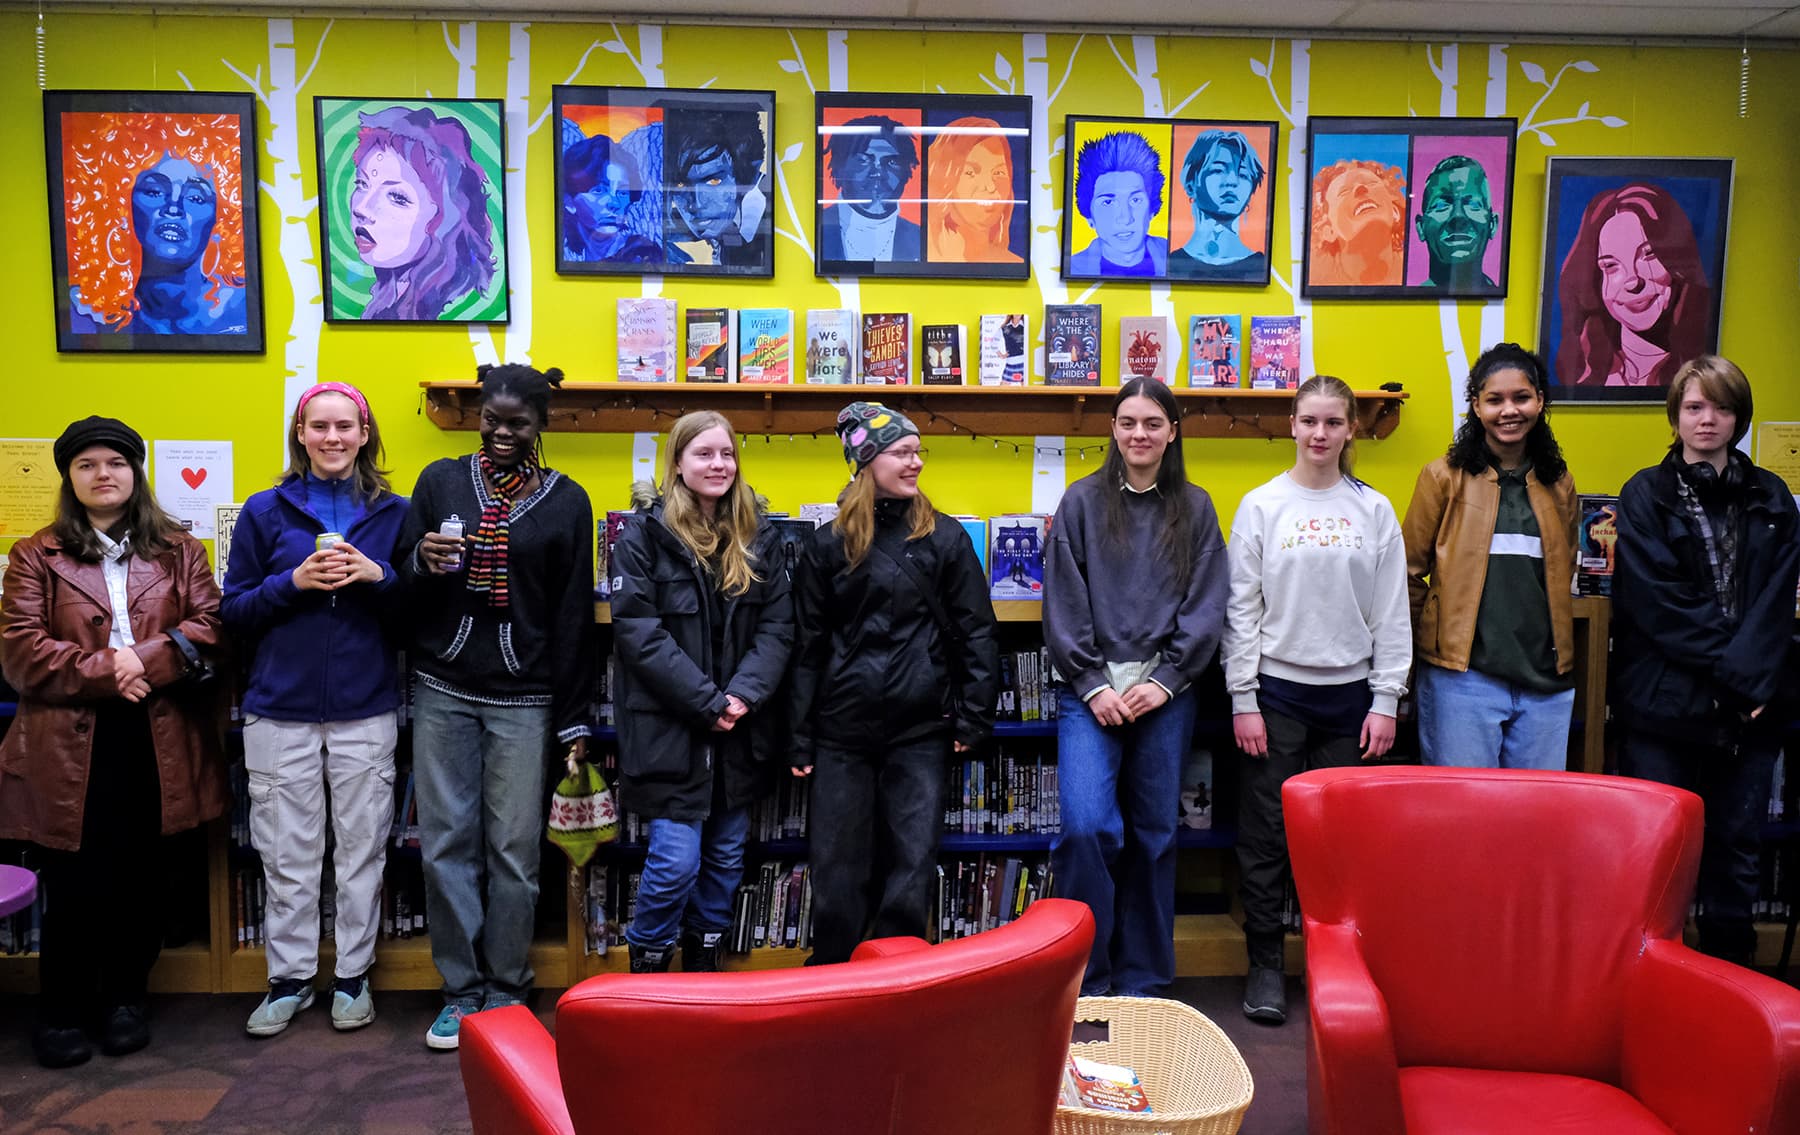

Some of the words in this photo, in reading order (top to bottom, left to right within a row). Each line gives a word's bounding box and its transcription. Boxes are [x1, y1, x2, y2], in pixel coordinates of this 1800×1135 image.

[751, 319, 778, 329] WHEN
[1059, 317, 1089, 326] WHERE
[819, 331, 838, 341] we
[928, 329, 952, 340] tithe
[1066, 326, 1082, 335] THE
[1203, 322, 1229, 341] MY
[749, 337, 779, 347] WORLD
[754, 347, 776, 359] TIPS
[812, 346, 847, 357] were
[870, 341, 901, 363] GAMBIT
[1192, 343, 1240, 360] SALTY
[751, 360, 777, 370] OVER
[813, 360, 843, 376] liars
[1058, 360, 1090, 369] LIBRARY
[1062, 370, 1085, 378] HIDES
[1192, 364, 1239, 382] MARY
[1296, 518, 1352, 531] GOOD
[1281, 534, 1363, 550] NATURED
